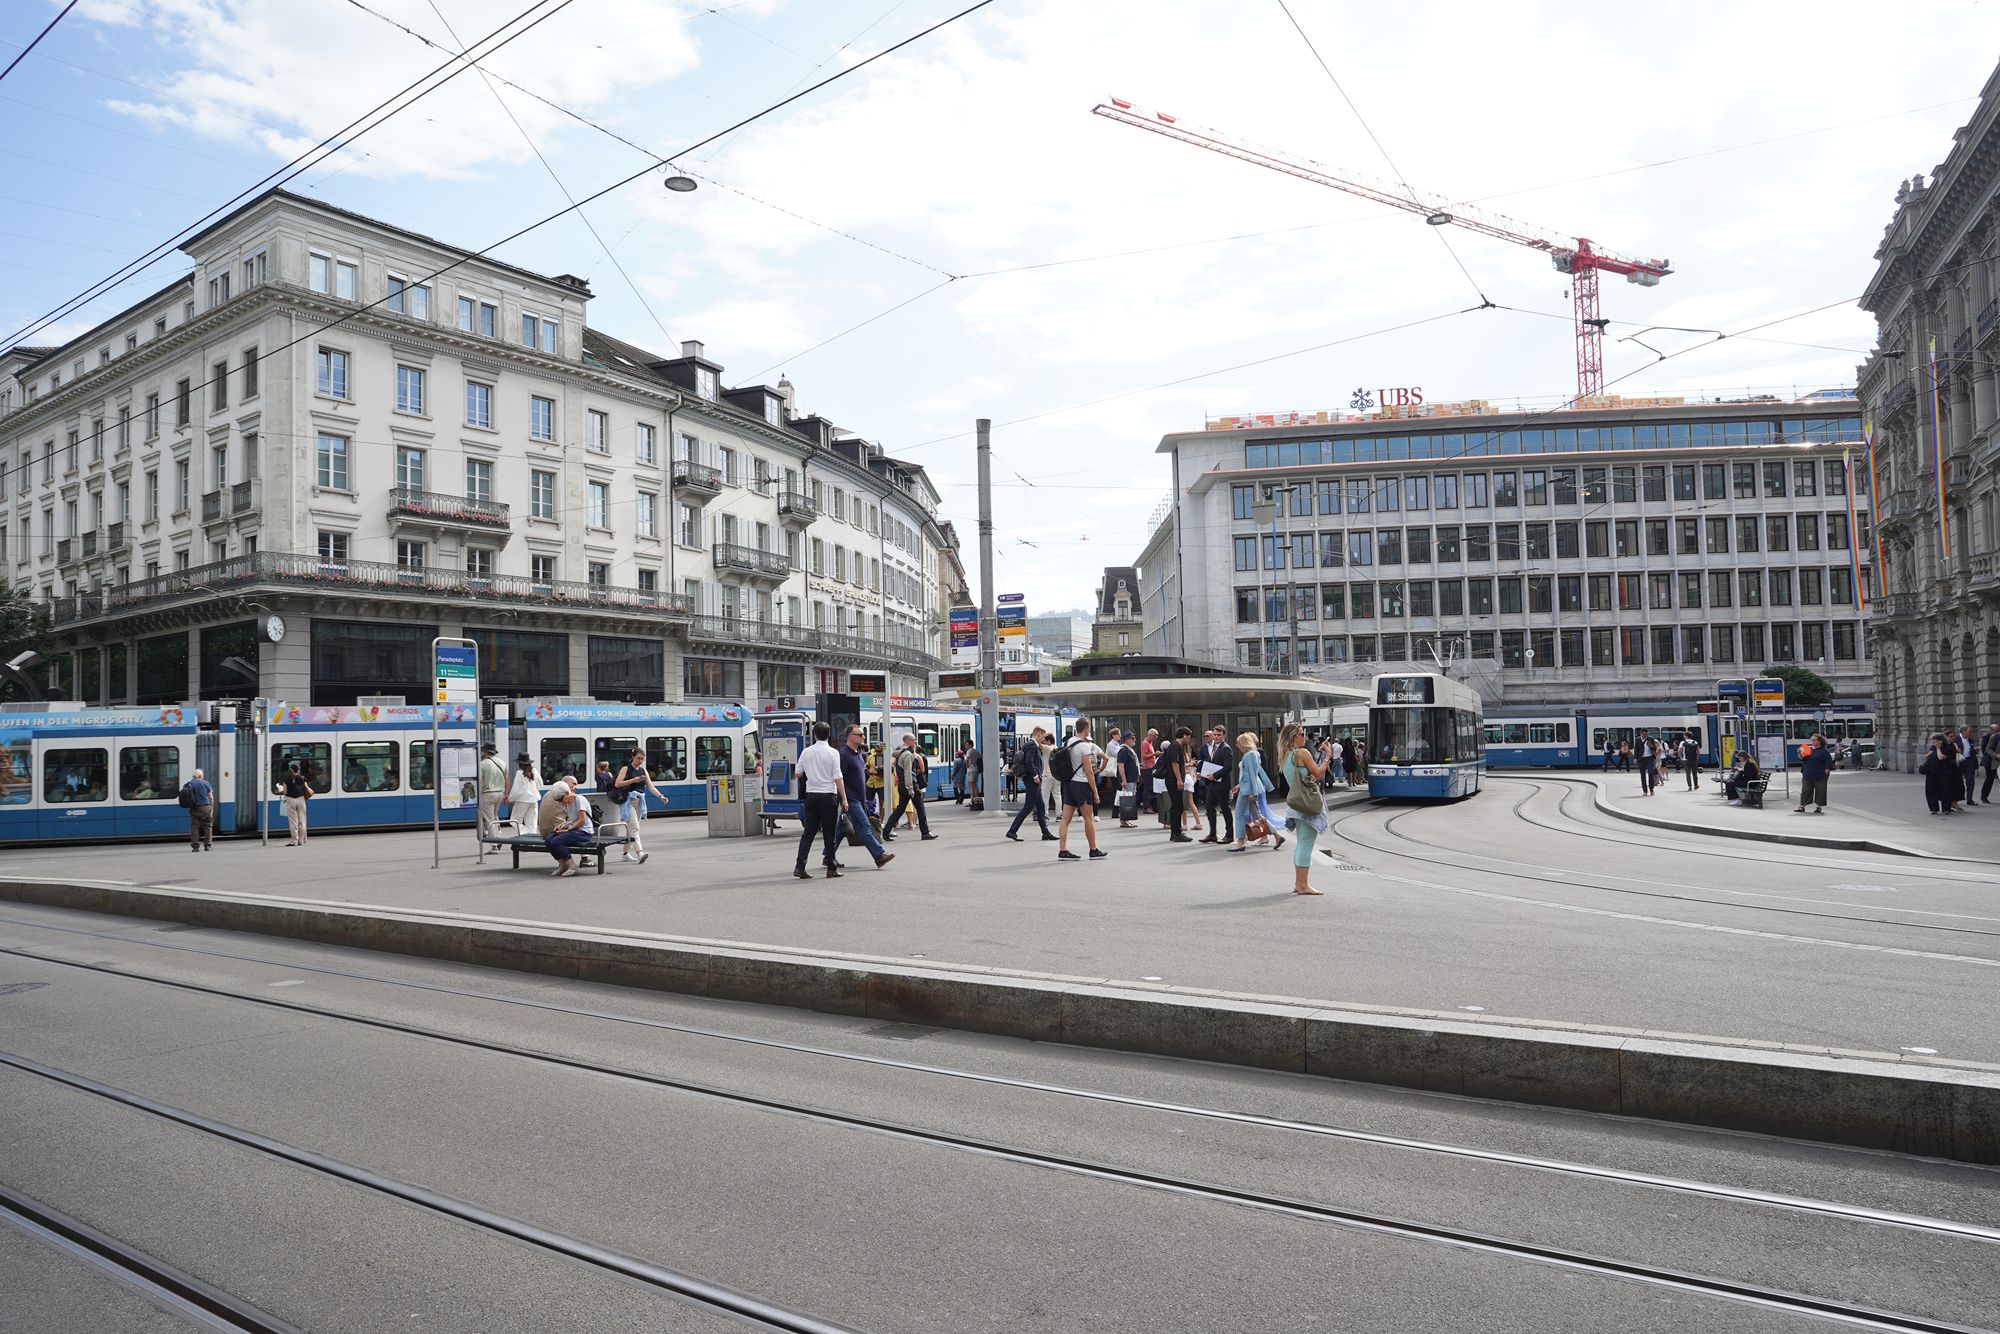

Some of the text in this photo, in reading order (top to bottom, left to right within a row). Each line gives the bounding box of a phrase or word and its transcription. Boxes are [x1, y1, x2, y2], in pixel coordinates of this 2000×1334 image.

[1378, 387, 1423, 407] UBS
[1401, 680, 1408, 689] 7
[1387, 693, 1422, 701] Bhf. Stettbach
[783, 699, 791, 708] 5
[873, 698, 903, 706] EXCENCE
[33, 718, 45, 726] IN
[72, 716, 114, 725] MIGROS
